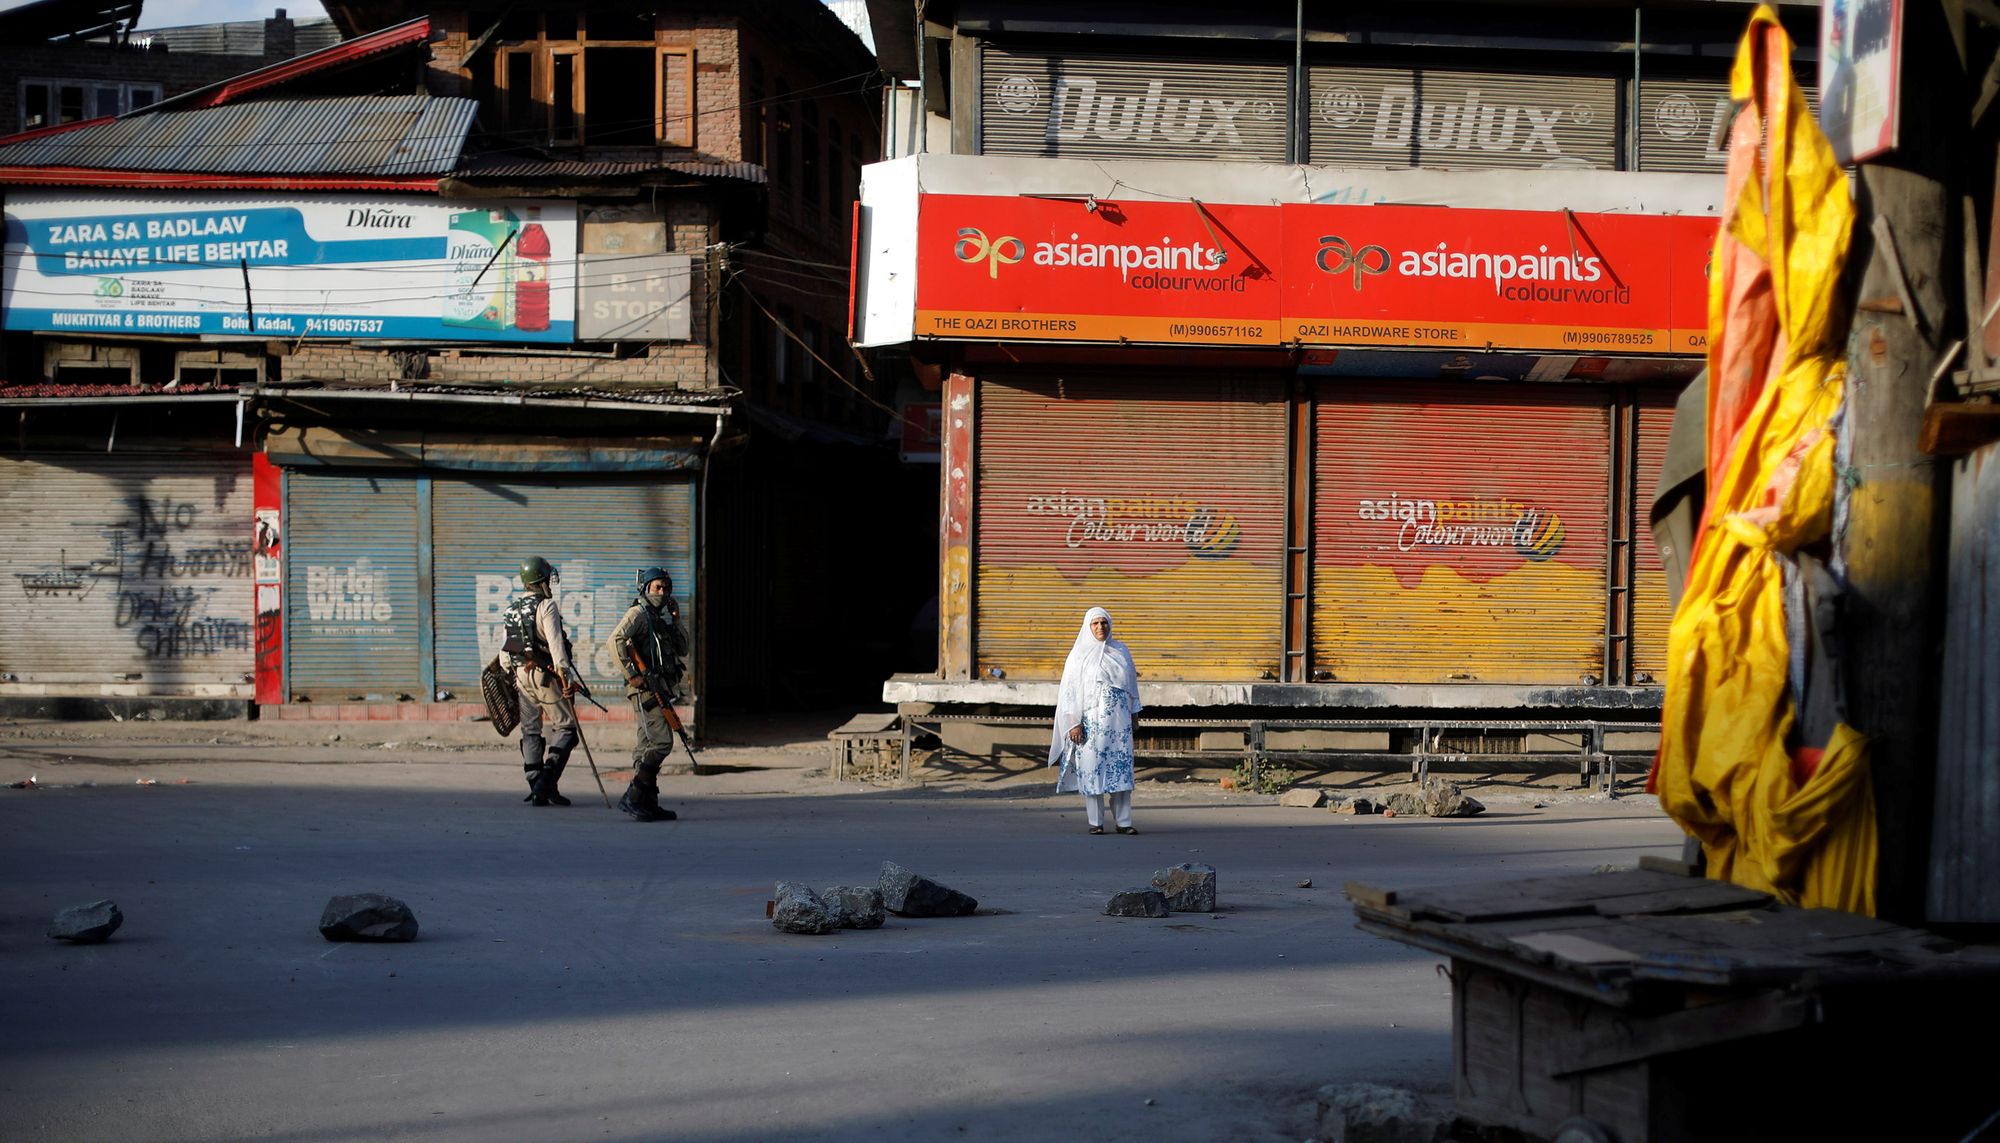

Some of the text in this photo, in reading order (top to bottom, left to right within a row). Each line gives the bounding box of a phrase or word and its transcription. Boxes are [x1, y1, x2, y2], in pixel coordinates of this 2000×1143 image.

[1045, 76, 1249, 145] Dulux
[1371, 84, 1565, 154] Dulux
[49, 215, 248, 244] ZARA SA BADLAAV
[65, 239, 289, 270] BANAYE LIFE BEHTAR
[1033, 232, 1222, 284] asianpaints
[1398, 241, 1601, 296] asianpaints
[611, 273, 665, 293] B. P.
[1131, 271, 1246, 293] colourworld
[1505, 281, 1631, 305] colourworld
[52, 313, 120, 327] MUKHTIYAR
[124, 314, 134, 327] &
[137, 314, 201, 328] BROTHERS
[257, 317, 296, 332] Kadal,
[305, 318, 385, 333] 9419057537
[593, 300, 682, 320] STORE
[934, 317, 1263, 338] THE QAZI BROTHERS (M)9906571162
[1298, 325, 1654, 345] QAZI HARDWARE STORE (M)9906789525
[1358, 491, 1525, 527] asianpaints
[307, 566, 374, 593] Birla
[307, 593, 393, 621] White
[476, 574, 594, 626] Bla
